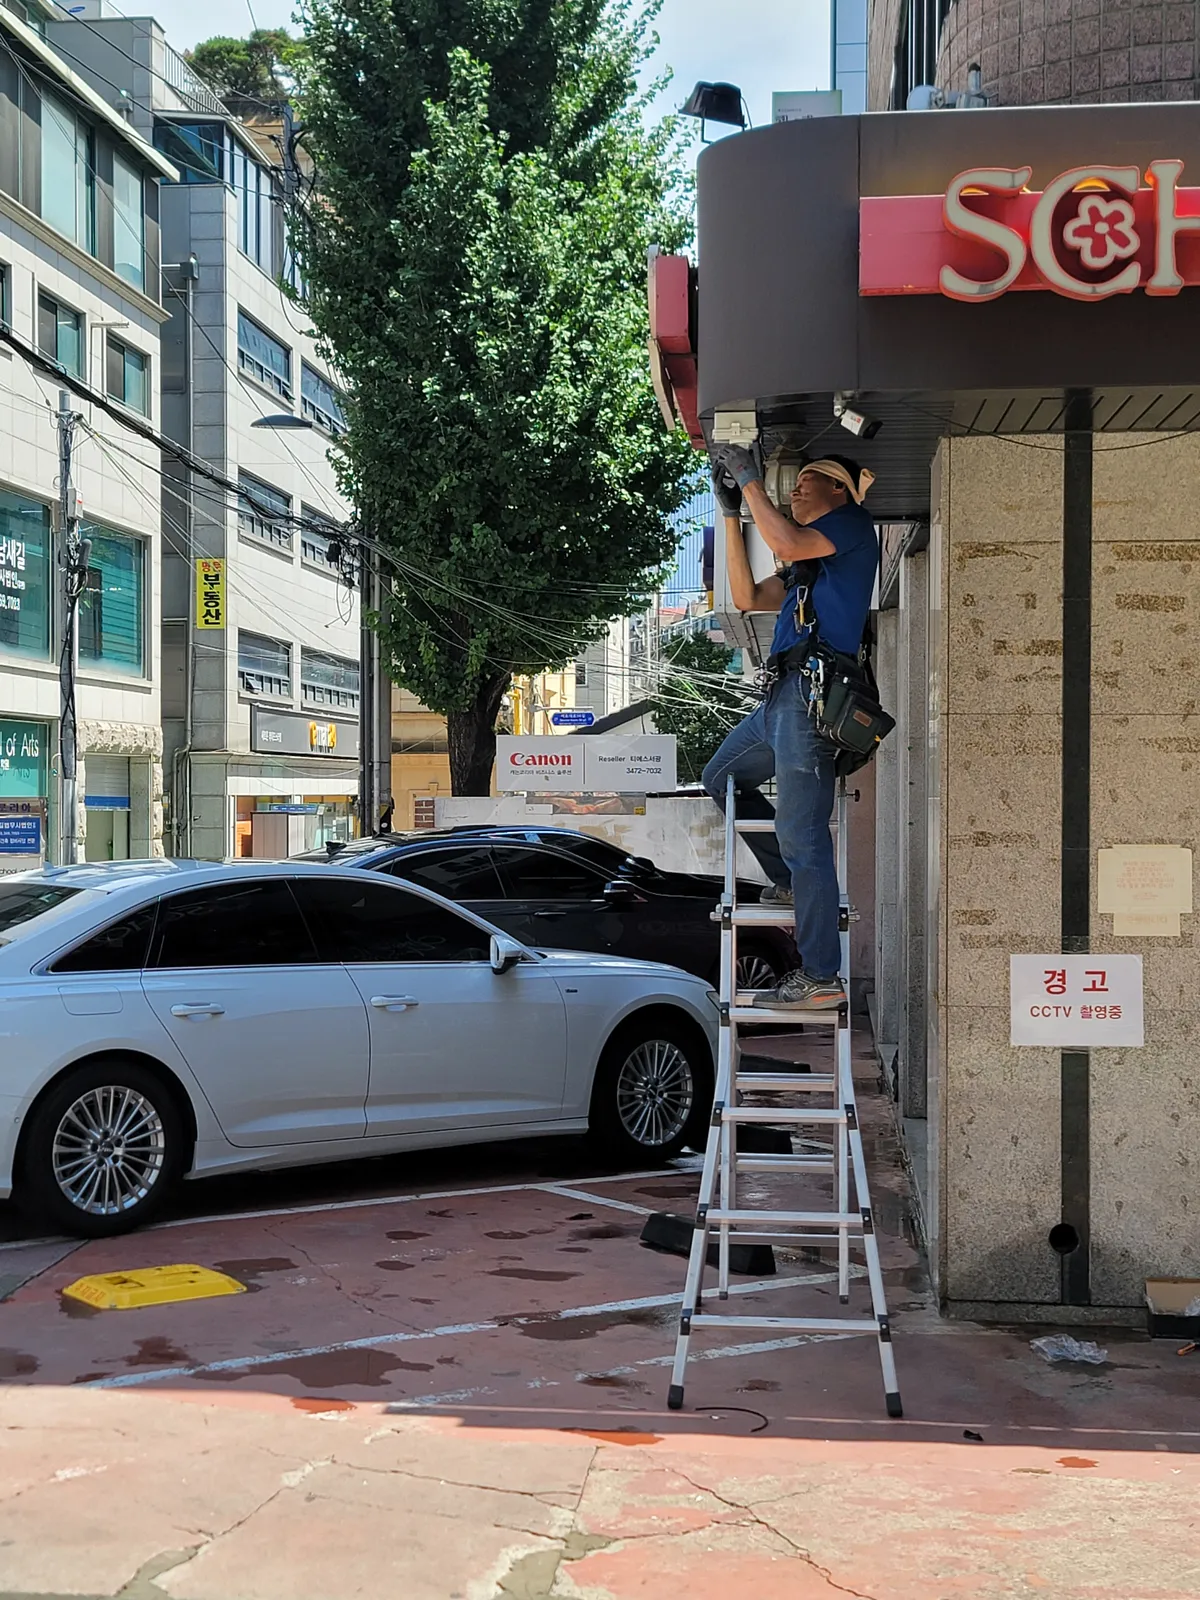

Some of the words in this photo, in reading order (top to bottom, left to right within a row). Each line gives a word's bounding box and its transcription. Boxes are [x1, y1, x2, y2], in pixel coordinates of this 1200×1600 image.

[202, 573, 221, 625] 부동산
[6, 732, 17, 757] of
[20, 733, 39, 757] Arts
[510, 752, 572, 766] Canon
[1030, 1005, 1073, 1018] CCTV
[1080, 1004, 1123, 1020] 촬영중
